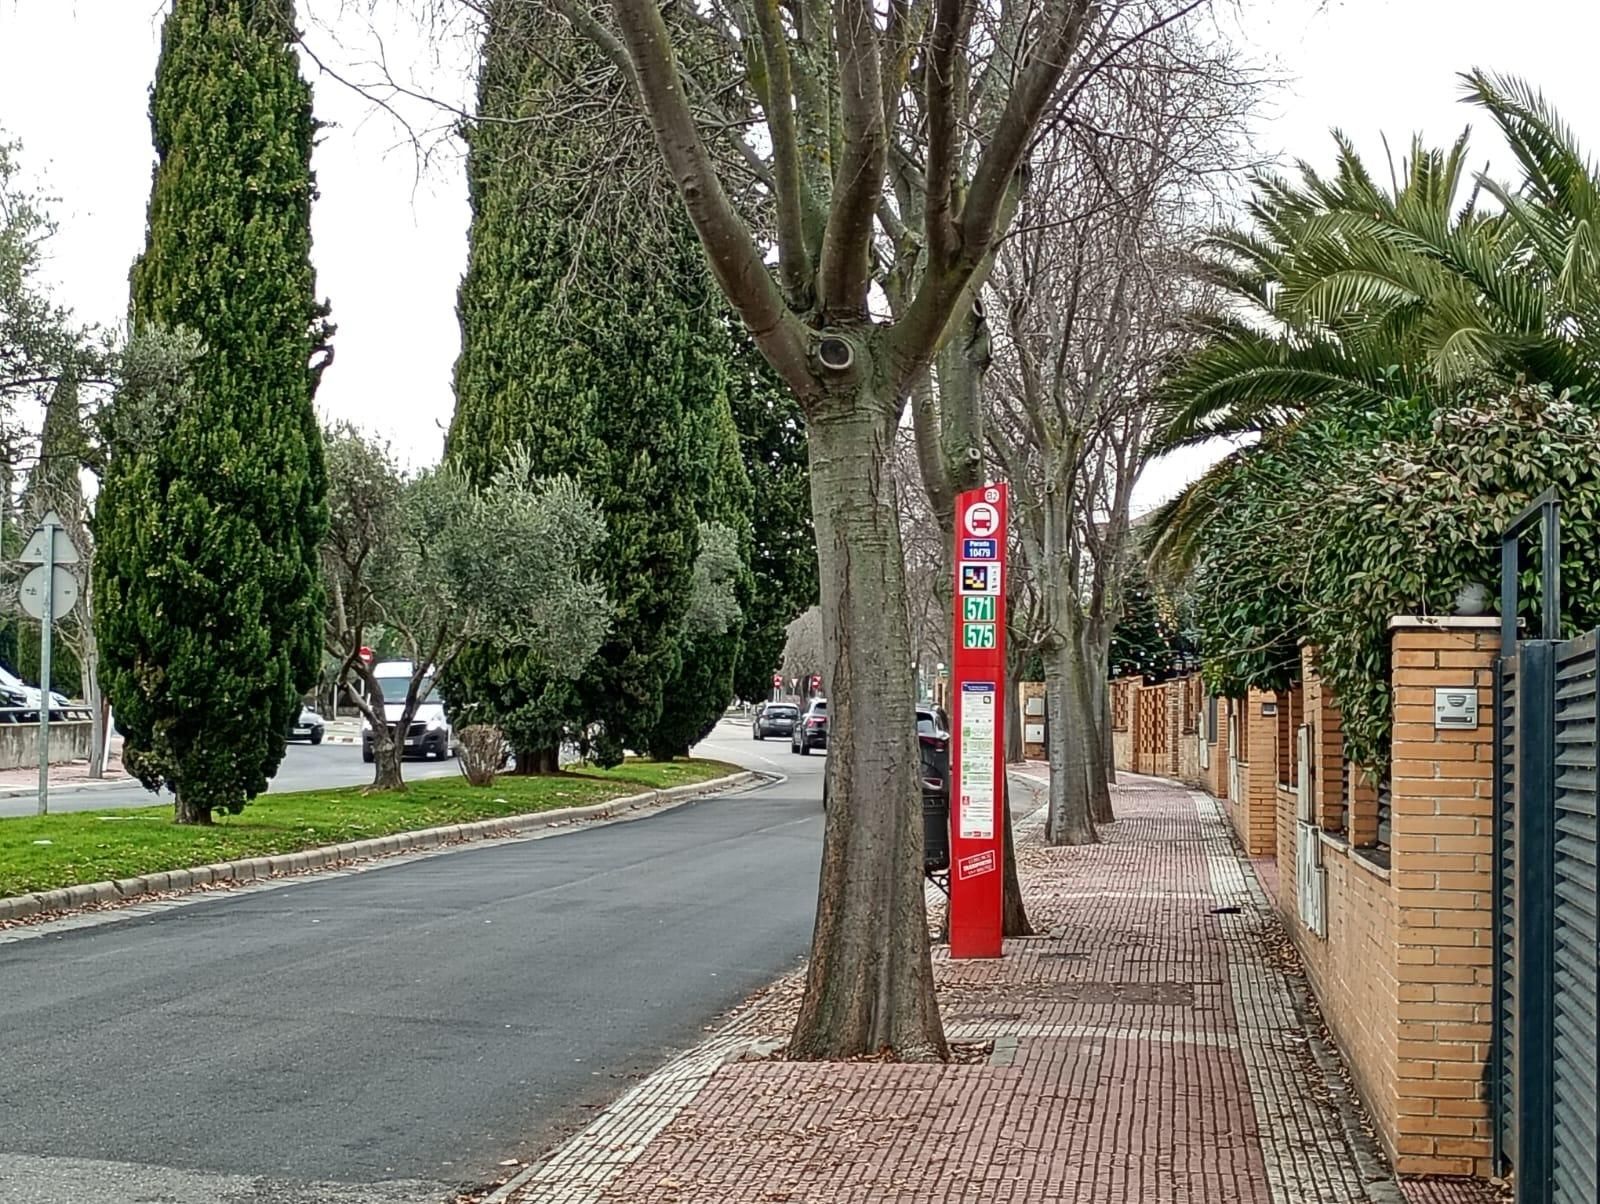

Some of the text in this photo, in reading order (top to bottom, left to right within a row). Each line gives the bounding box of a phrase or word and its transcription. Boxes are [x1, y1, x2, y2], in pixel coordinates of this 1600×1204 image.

[969, 548, 990, 557] 10479
[968, 596, 991, 620] 571
[968, 624, 993, 648] 575
